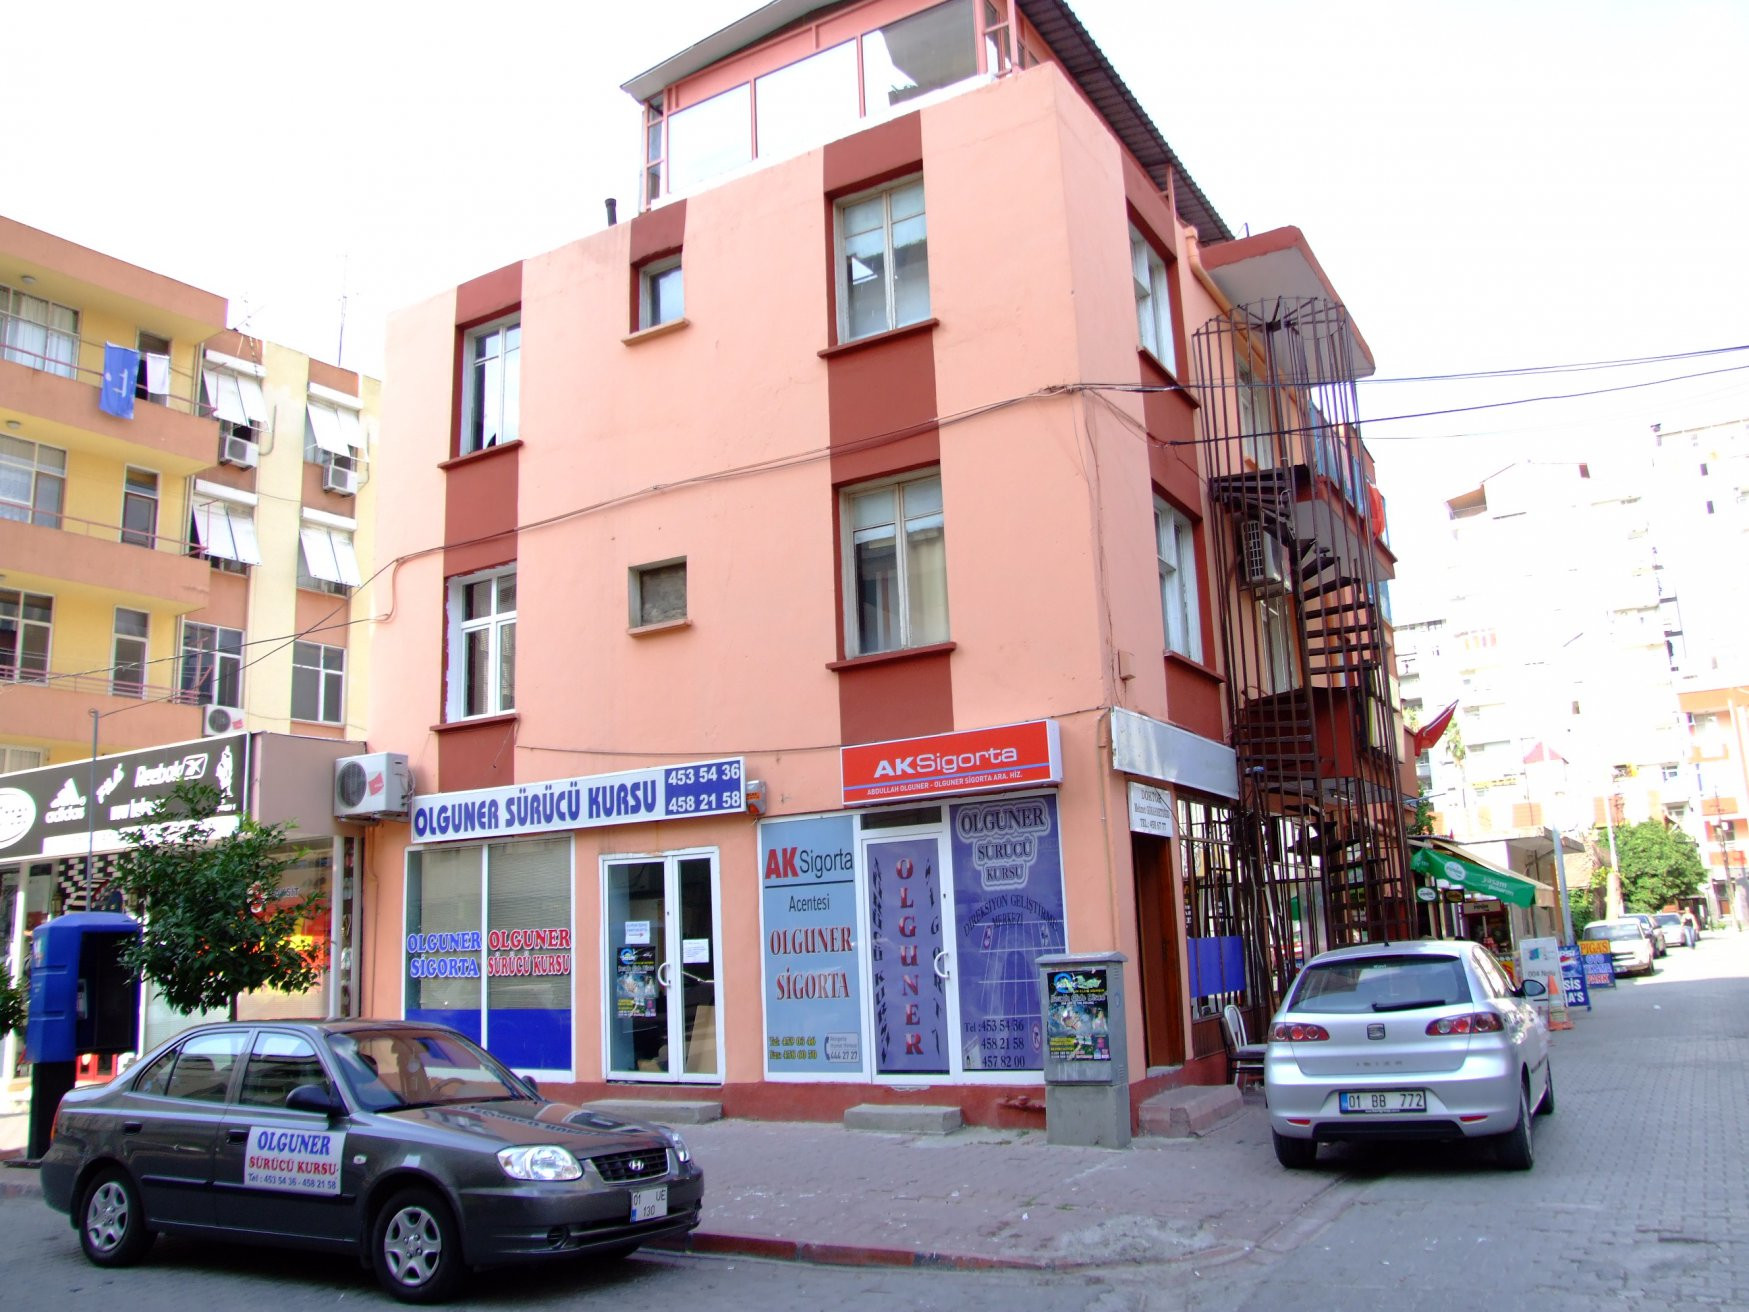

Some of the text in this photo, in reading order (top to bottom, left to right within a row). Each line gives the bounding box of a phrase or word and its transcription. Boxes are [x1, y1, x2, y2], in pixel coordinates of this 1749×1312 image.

[668, 763, 740, 786] 453 54 36
[866, 785, 900, 797] ABDULLAH
[900, 782, 930, 792] OLGUNER
[934, 777, 964, 789] OLGUNER
[965, 773, 993, 786] SİGORTA
[414, 780, 657, 837] OLGUNER SÜRÜCÜ KURSU
[668, 796, 696, 813] 458
[700, 793, 716, 811] 21
[722, 791, 741, 808] 58
[961, 807, 1044, 834] OLGUNER
[977, 835, 1032, 861] SÜRÜCÜ
[986, 864, 1024, 881] KURSU
[788, 893, 830, 912] Acentesi
[407, 931, 482, 953] OLGUNER
[488, 928, 571, 951] OLGUNER
[769, 926, 853, 956] OLGUNER
[410, 954, 480, 978] SİGORTA
[488, 951, 571, 977] SÜRÜCÜ KURSU
[896, 858, 924, 1055] OLGUNER
[776, 967, 850, 1000] SİGORTA
[981, 1037, 1025, 1050] 458 21 58
[982, 1055, 1025, 1068] 457 82 00
[1348, 1093, 1423, 1108] 01 BB 772
[257, 1131, 331, 1155] OLGUNER
[248, 1155, 337, 1175] SÜRÜCÜ KURSU
[263, 1174, 276, 1185] 453
[278, 1176, 287, 1185] 54
[302, 1178, 316, 1188] 458
[316, 1179, 325, 1189] 21
[327, 1180, 337, 1190] 58
[643, 1205, 655, 1217] 130
